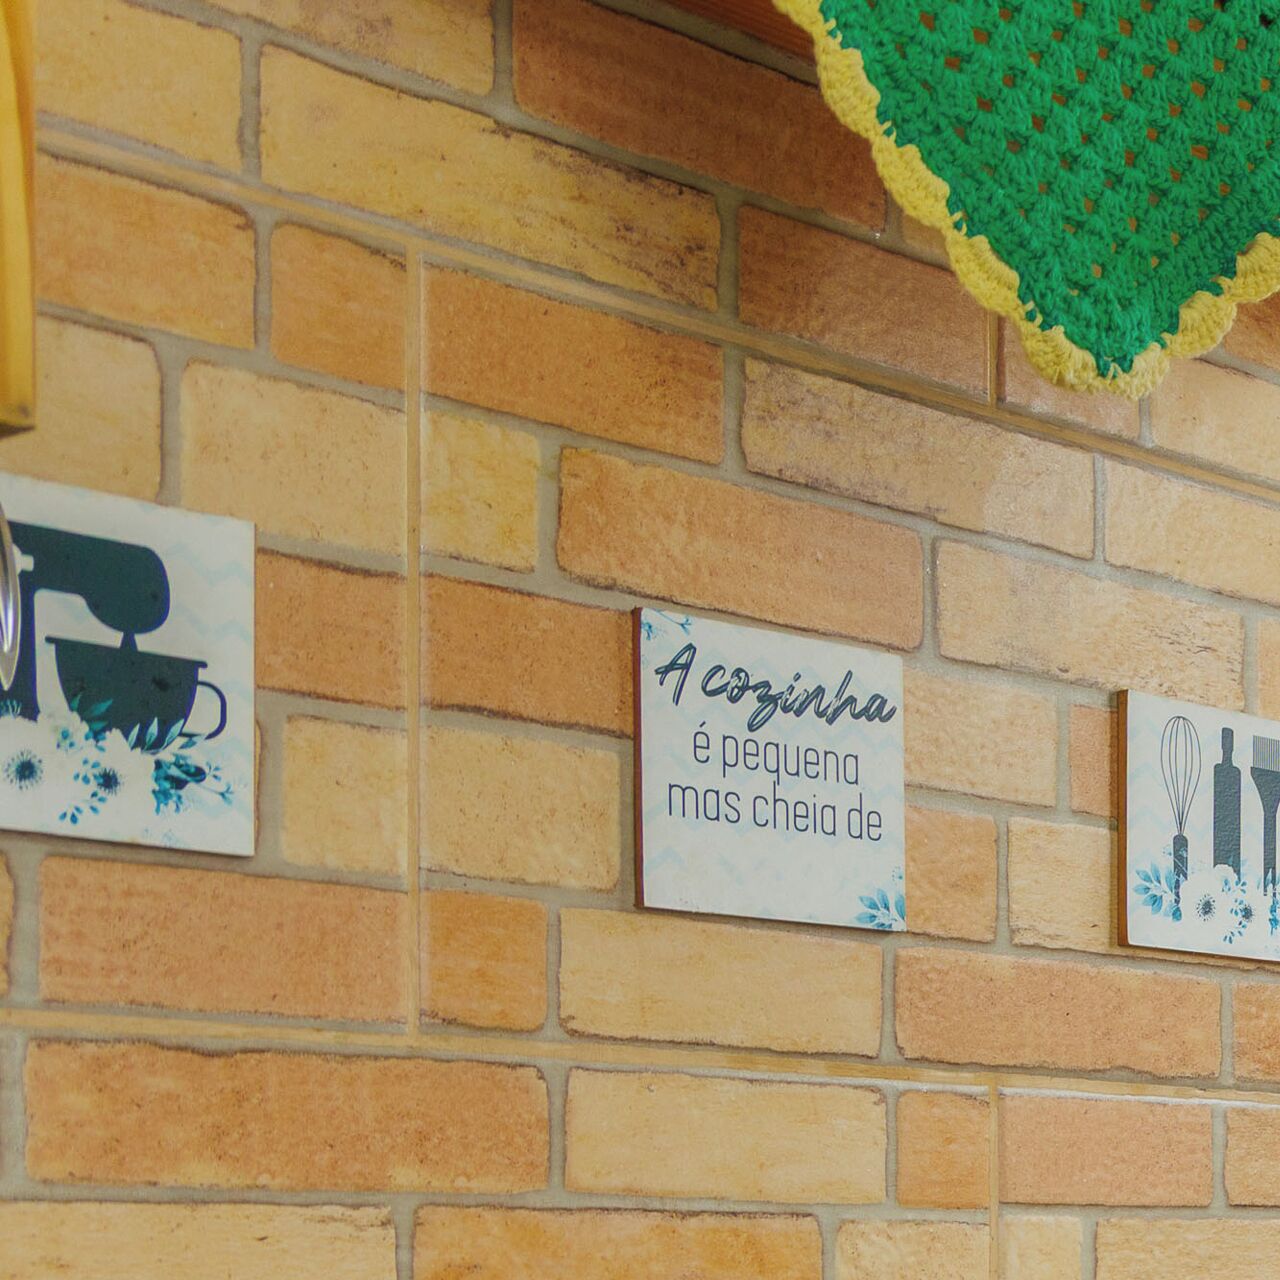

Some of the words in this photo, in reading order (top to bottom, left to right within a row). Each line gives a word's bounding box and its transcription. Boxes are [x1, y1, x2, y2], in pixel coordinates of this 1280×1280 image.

[654, 642, 698, 707] A
[700, 664, 898, 733] cozinha
[693, 720, 711, 764] é
[722, 734, 860, 787] pequena
[668, 782, 741, 824] mas
[752, 780, 837, 837] cheia
[847, 792, 882, 842] de
